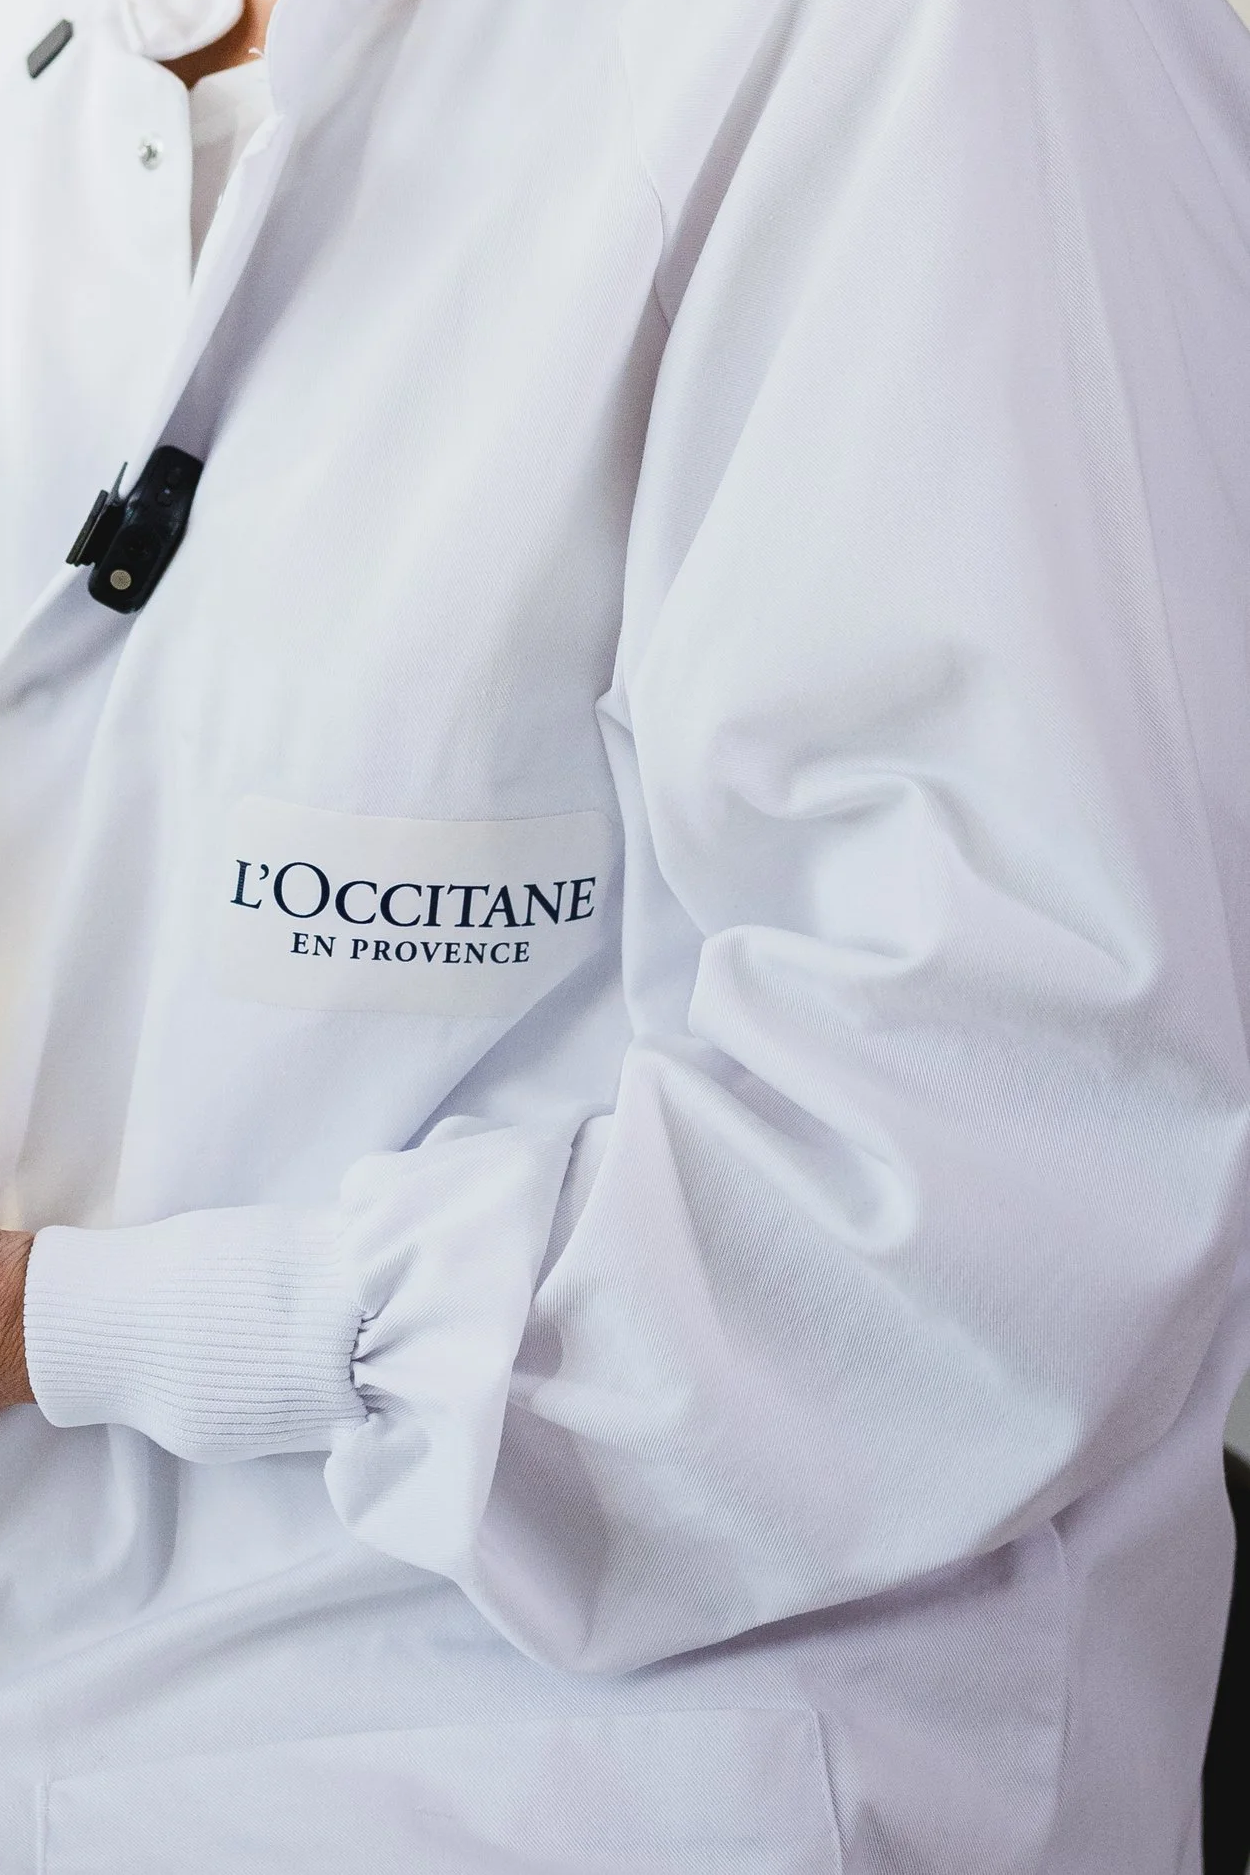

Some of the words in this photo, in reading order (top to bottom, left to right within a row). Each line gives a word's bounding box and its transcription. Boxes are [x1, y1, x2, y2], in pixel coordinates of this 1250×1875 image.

[230, 859, 596, 928] L'OCCITANE
[290, 932, 336, 957] EN
[350, 938, 530, 964] PROVENCE
